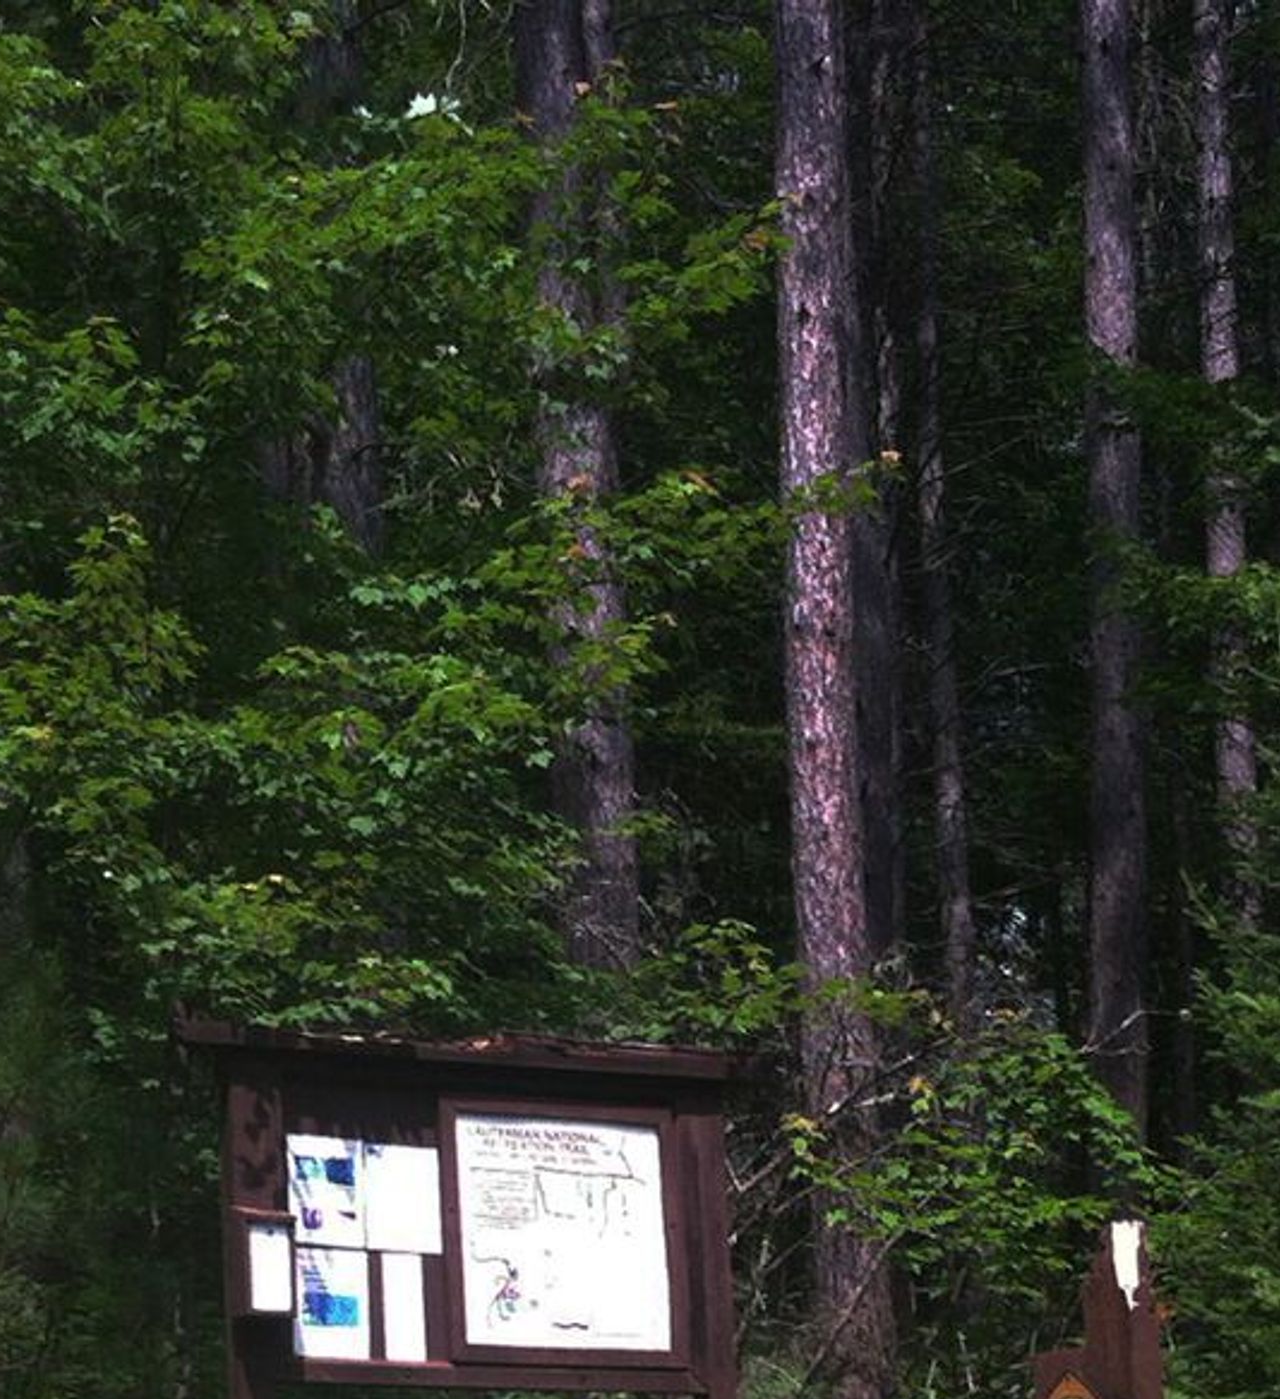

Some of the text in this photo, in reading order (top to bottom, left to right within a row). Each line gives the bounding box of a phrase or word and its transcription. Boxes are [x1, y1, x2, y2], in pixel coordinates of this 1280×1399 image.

[544, 1129, 607, 1146] NATIONAL
[482, 1138, 555, 1152] REREATION
[559, 1142, 591, 1156] TRAIL
